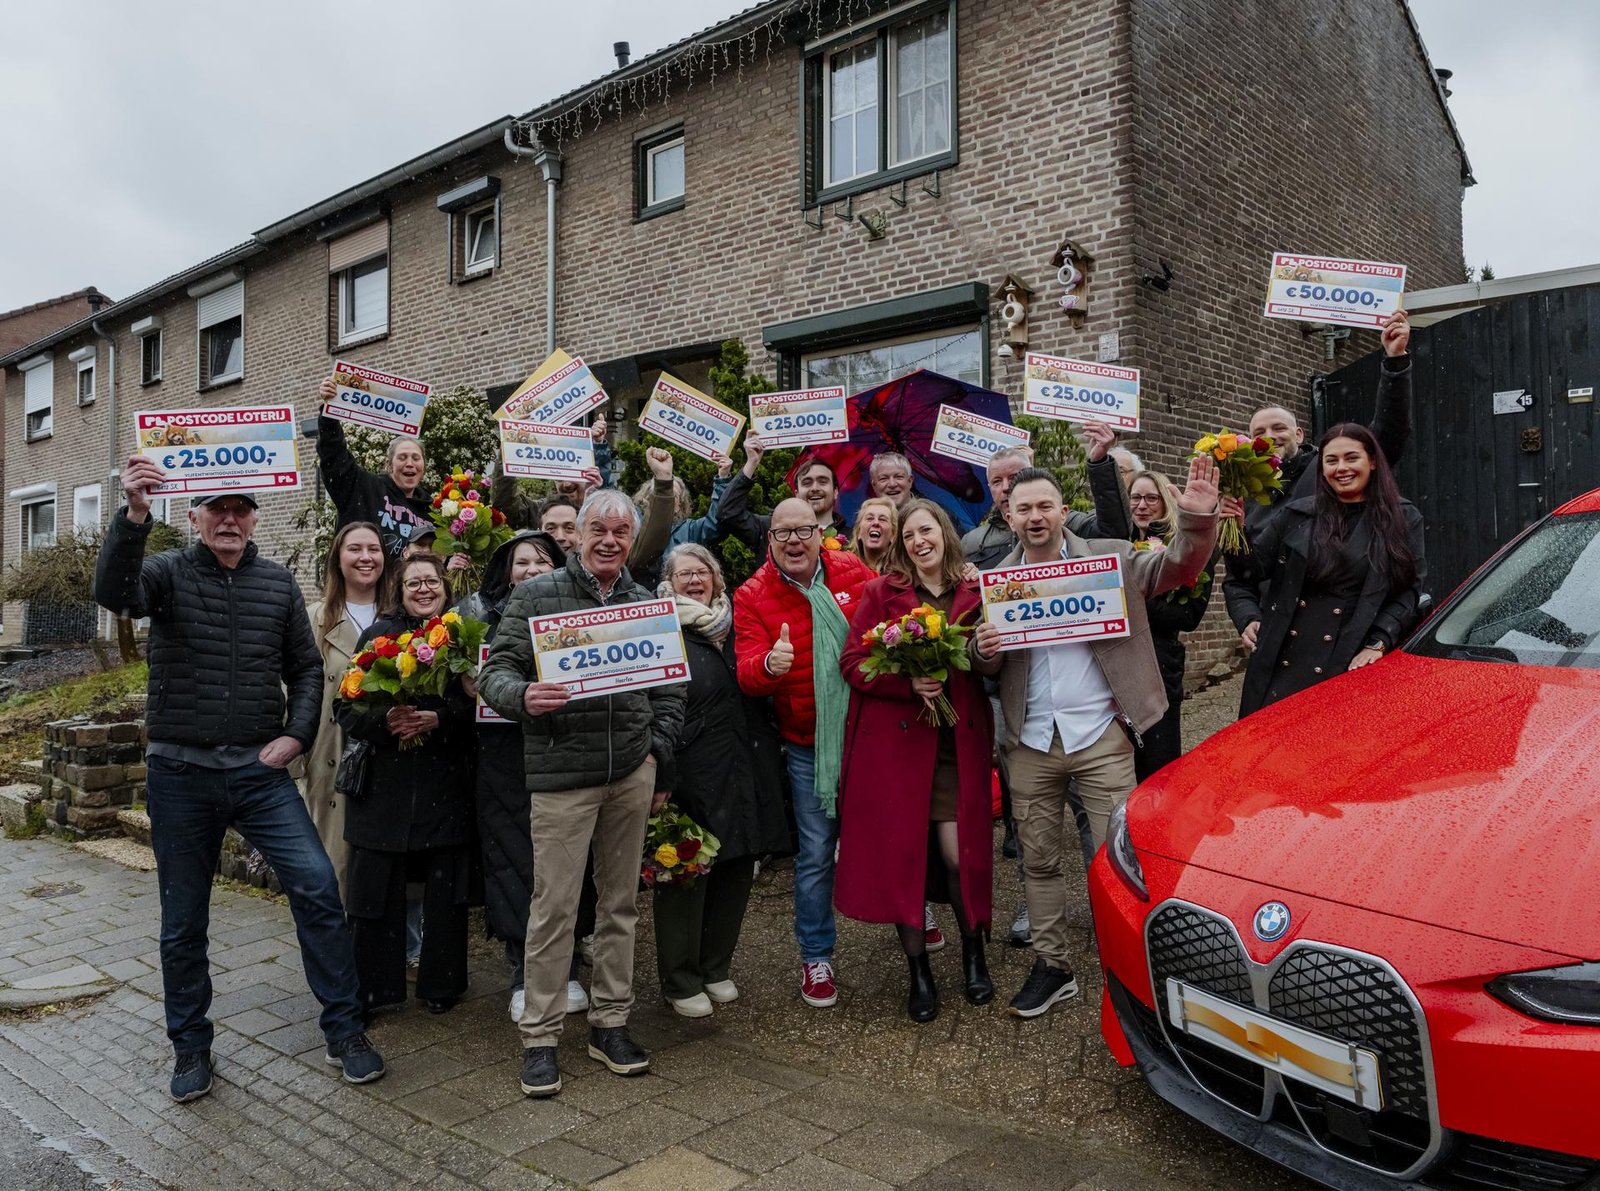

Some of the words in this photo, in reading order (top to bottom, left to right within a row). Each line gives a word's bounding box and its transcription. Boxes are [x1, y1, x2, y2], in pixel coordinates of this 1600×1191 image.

[1298, 258, 1354, 272] POSTCODE
[1355, 264, 1399, 276] LOTERIJ
[1300, 284, 1384, 309] 50.000,-
[353, 367, 395, 385] POSTCODE
[396, 378, 426, 393] LOTERIJ
[519, 378, 555, 403] POSTCODE
[553, 361, 579, 380] LOTERIJ
[1047, 360, 1097, 374] POSTCODE
[1097, 367, 1133, 379] LOTERIJ
[351, 391, 412, 418] 50.000,-
[673, 390, 710, 411] POSTCODE
[709, 406, 737, 425] LOTERIJ
[768, 393, 809, 404] POSTCODE
[809, 390, 840, 399] LOTERIJ
[1052, 385, 1124, 410] 25.000,-
[1520, 394, 1533, 406] 15
[167, 414, 235, 426] POSTCODE
[236, 410, 286, 423] LOTERIJ
[519, 423, 558, 435] POSTCODE
[557, 428, 587, 437] LOTERIJ
[667, 411, 720, 445] 25.000,-
[774, 413, 834, 430] 25.000,-
[957, 413, 996, 430] POSTCODE
[996, 424, 1026, 438] LOTERIJ
[178, 445, 277, 469] 25.000,-
[525, 446, 582, 465] 25.000,-
[1007, 566, 1067, 581] POSTCODE
[1067, 559, 1113, 574] LOTERIJ
[560, 611, 622, 628] POSTCODE
[623, 603, 669, 618] LOTERIJ
[1017, 595, 1106, 621] 25.000,-
[572, 639, 665, 669] 25.000,-
